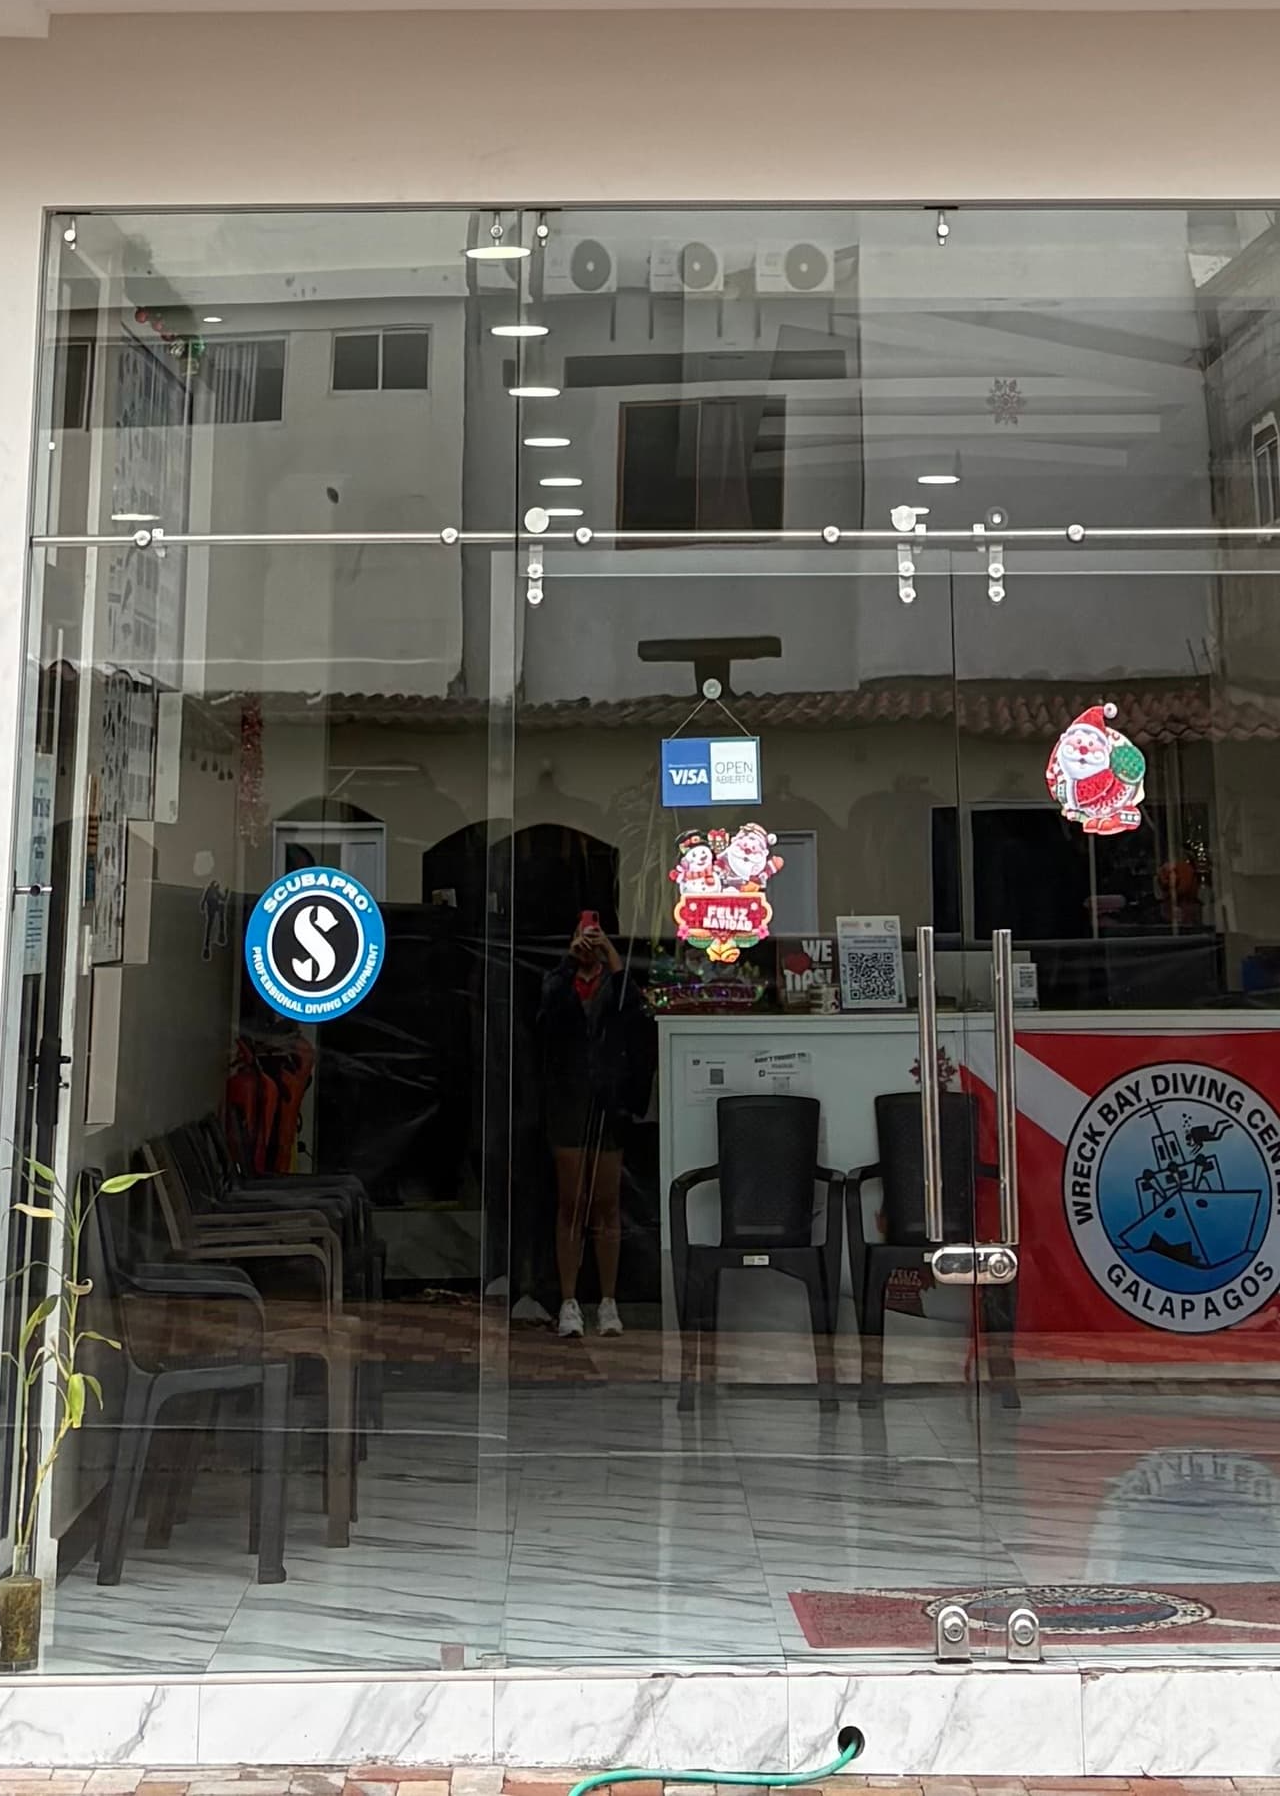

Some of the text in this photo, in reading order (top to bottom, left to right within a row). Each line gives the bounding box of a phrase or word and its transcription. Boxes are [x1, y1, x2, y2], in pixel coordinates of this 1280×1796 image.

[668, 768, 709, 785] VISA
[714, 761, 753, 775] OPEN
[715, 775, 755, 784] ABIERTO
[263, 873, 369, 913] SCUBAPRO
[706, 904, 749, 920] FELIZ
[702, 916, 753, 932] NAVIDAD
[801, 939, 833, 962] WE
[252, 943, 380, 1015] PROFESSIONAL DIVING EQUIPMENT
[1071, 1124, 1106, 1226] WRECK
[1097, 1080, 1145, 1124] BAY
[1150, 1072, 1246, 1115] DIVING
[1106, 1260, 1275, 1320] GALAPAGOS
